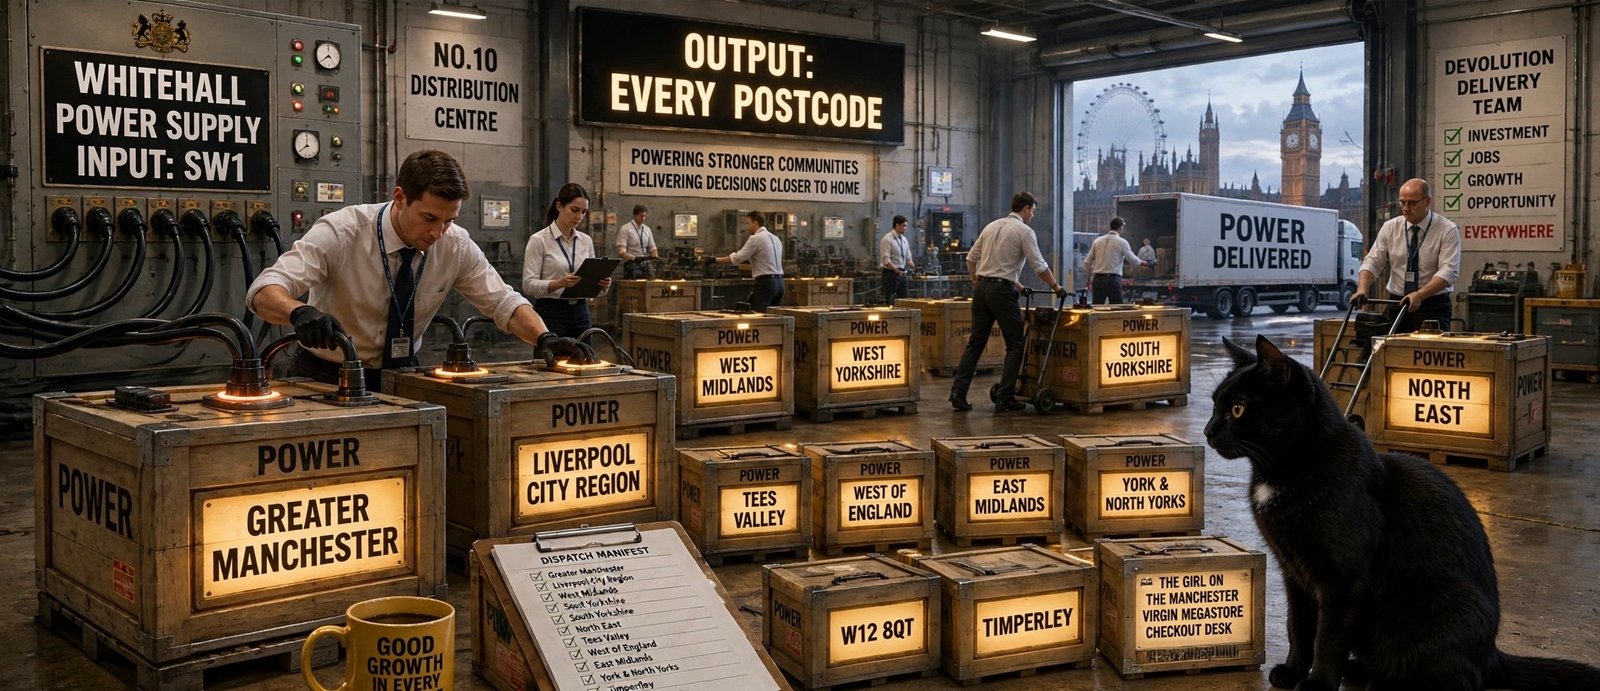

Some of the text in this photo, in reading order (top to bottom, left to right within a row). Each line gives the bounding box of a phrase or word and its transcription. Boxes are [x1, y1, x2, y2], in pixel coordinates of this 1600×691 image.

[434, 42, 498, 73] NO.10
[684, 32, 814, 79] OUTPUT:
[1445, 49, 1555, 76] DEVOLUTION
[74, 60, 246, 106] WHITEHALL
[411, 74, 519, 103] DISTRIBUTION
[1457, 72, 1541, 96] DELIVERY
[610, 72, 883, 130] EVERY POSTCODE
[1473, 97, 1522, 115] TEAM
[56, 102, 262, 144] POWER SUPPLY
[434, 107, 498, 132] CENTRE
[1468, 125, 1550, 142] INVESTMENT
[77, 145, 244, 182] INPUT: SW1
[631, 148, 859, 175] POWERING STRONGER COMMUNITIES
[1467, 151, 1500, 165] JOBS
[629, 171, 860, 195] DELIVERING DECISIONS CLOSER TO HOME
[1467, 172, 1523, 187] GROWTH
[1467, 194, 1556, 210] OPPORTUNITY
[1220, 213, 1305, 244] POWER
[1464, 224, 1554, 239] EVERYWHERE
[1213, 246, 1312, 269] DELIVERED
[851, 320, 889, 335] POWER
[1122, 319, 1159, 332] POWER
[718, 329, 760, 345] POWER
[636, 346, 672, 372] POWER
[852, 346, 887, 361] WEST
[1120, 341, 1160, 358] SOUTH
[1413, 350, 1466, 368] POWER
[720, 356, 758, 374] WEST
[835, 363, 901, 382] YORKSHIRE
[1106, 359, 1173, 378] YORKSHIRE
[702, 376, 774, 396] MIDLANDS
[1408, 378, 1470, 400] NORTH
[1517, 371, 1543, 398] POWER
[551, 400, 620, 428] POWER
[1415, 403, 1464, 425] EAST
[257, 437, 361, 476] POWER
[533, 443, 636, 475] LIVERPOOL
[990, 457, 1030, 470] POWER
[1125, 454, 1166, 468] POWER
[739, 468, 780, 482] POWER
[860, 462, 901, 476] POWER
[527, 470, 641, 505] CITY REGION
[854, 484, 908, 501] WEST OF
[993, 479, 1027, 494] EAST
[1122, 477, 1169, 492] YORK &
[58, 462, 134, 540] POWER
[742, 490, 777, 508] TEES
[975, 497, 1045, 515] MIDLANDS
[1105, 494, 1186, 511] NORTH YORKS
[246, 493, 370, 537] GREATER
[734, 510, 786, 529] VALLEY
[849, 502, 913, 521] ENGLAND
[212, 526, 400, 582] MANCHESTER
[540, 547, 649, 565] DISPATCH MANIFEST
[548, 570, 578, 579] Greater
[1159, 576, 1179, 589] THE
[1182, 575, 1206, 588] GIRL
[1209, 574, 1224, 587] ON
[1146, 589, 1239, 606] THE MANCHESTER
[569, 609, 595, 622] South
[774, 600, 802, 630] POWER
[982, 608, 1073, 638] TIMPERLEY
[1142, 605, 1244, 622] VIRGIN MEGASTORE
[575, 620, 622, 634] North East
[841, 618, 915, 645] W12 8QT
[1146, 622, 1232, 638] CHECKOUT DESK
[377, 636, 435, 657] GOOD
[581, 632, 629, 645] Tees Valley
[588, 640, 657, 657] West of England
[367, 653, 443, 676] GROWTH
[594, 660, 614, 670] East
[600, 662, 679, 683] York & North Yorks
[372, 673, 441, 691] IN EVERY
